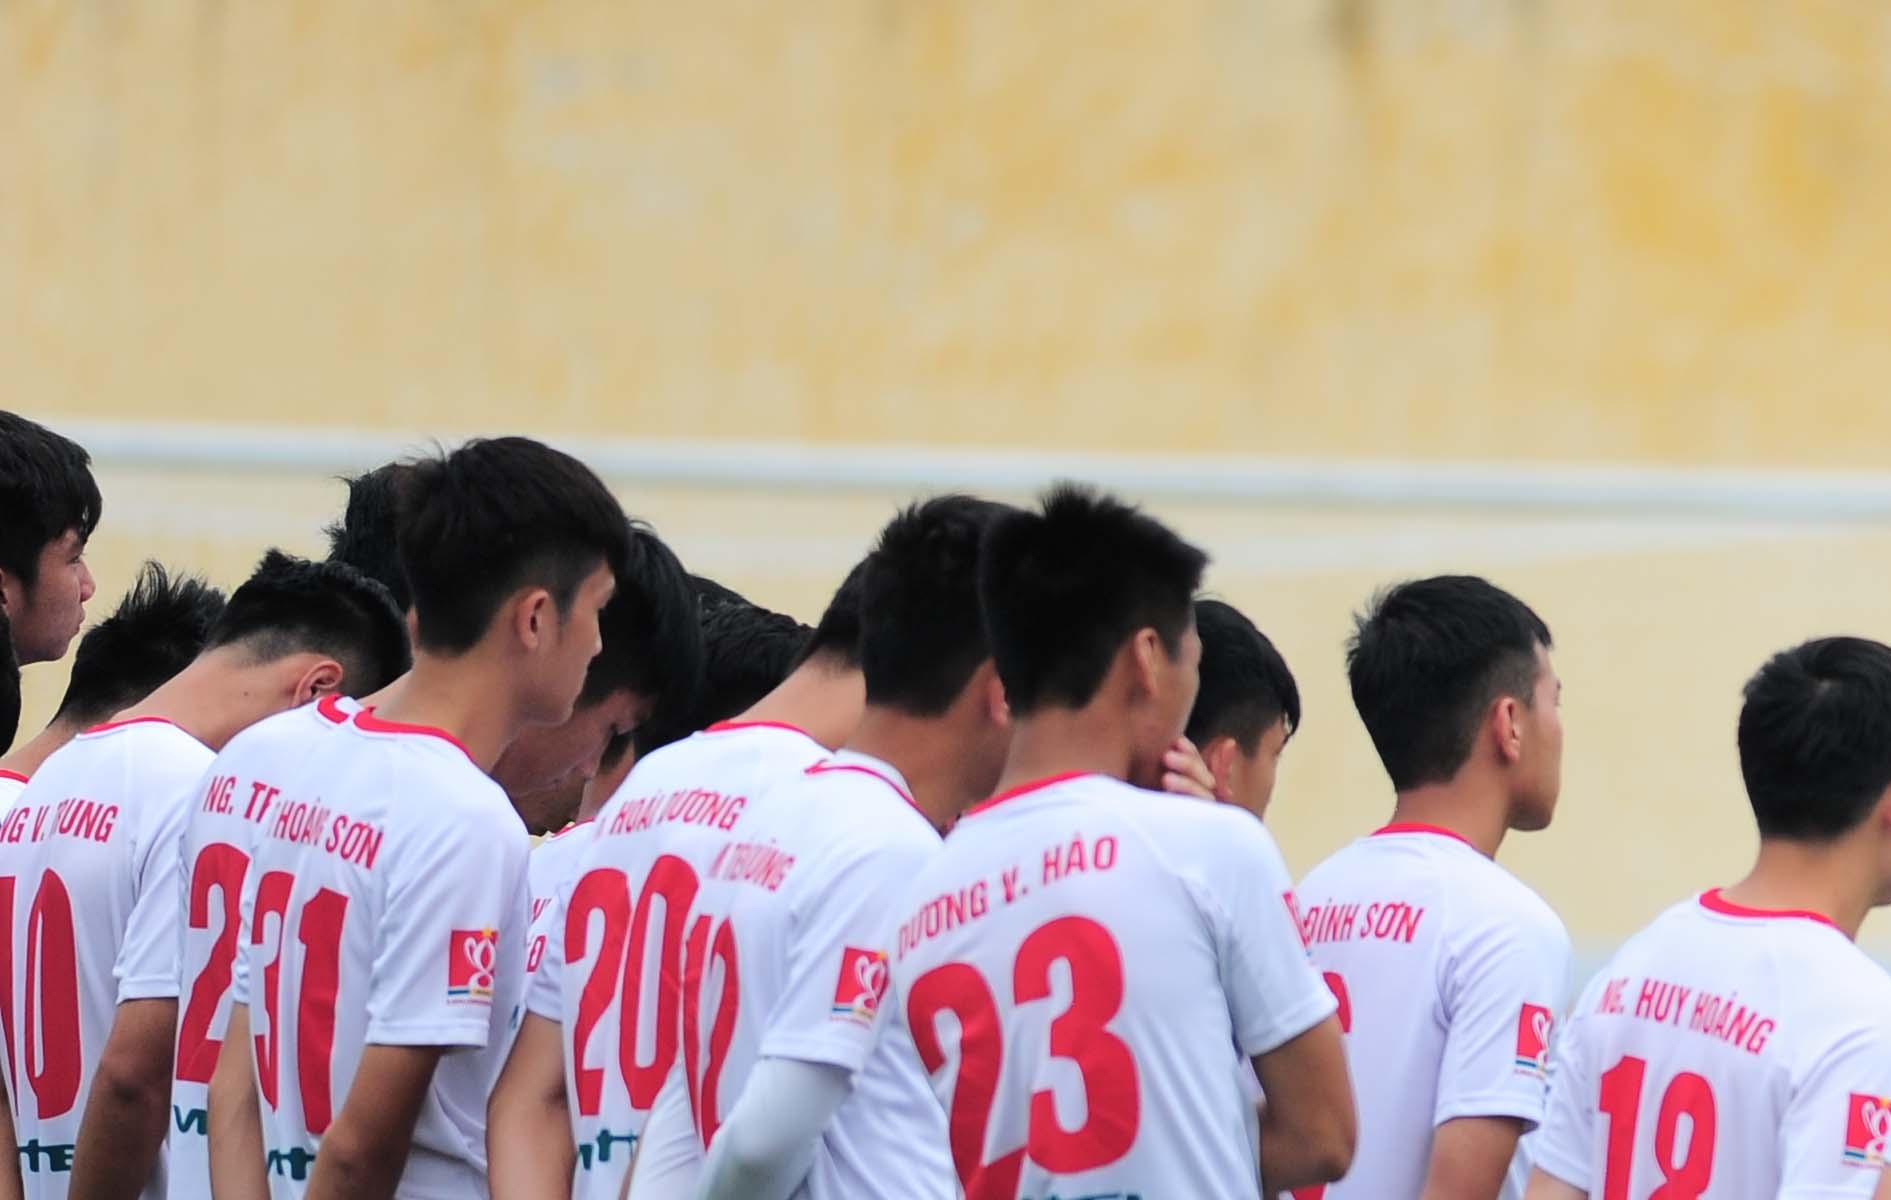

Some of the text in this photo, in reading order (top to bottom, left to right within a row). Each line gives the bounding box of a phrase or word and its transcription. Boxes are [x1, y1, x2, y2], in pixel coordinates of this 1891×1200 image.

[1359, 900, 1425, 943] SƠN
[565, 854, 700, 1117] 20
[1634, 978, 1692, 1028] HUY
